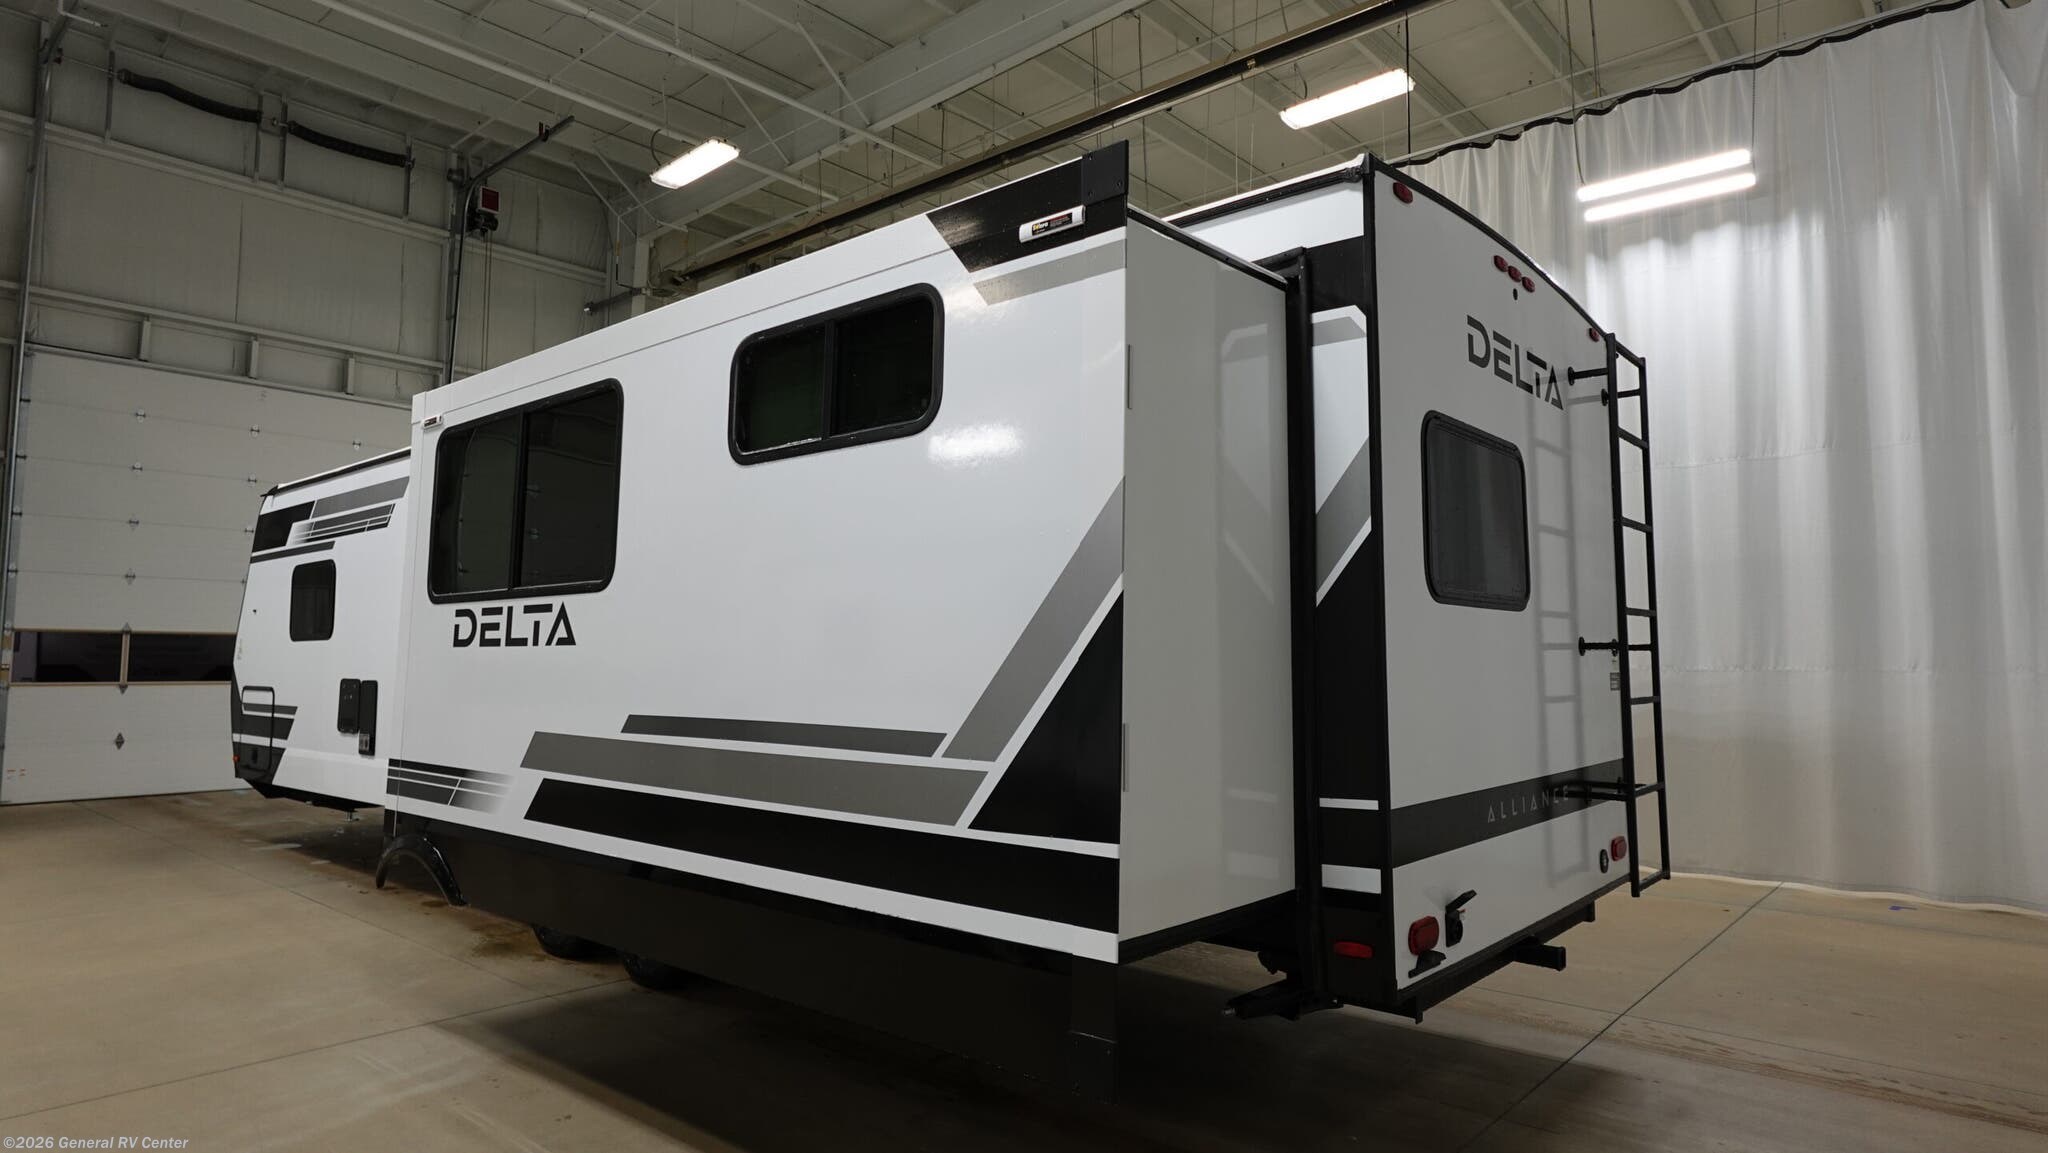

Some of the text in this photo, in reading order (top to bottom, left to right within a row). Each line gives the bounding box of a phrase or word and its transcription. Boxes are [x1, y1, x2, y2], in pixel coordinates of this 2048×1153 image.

[1467, 314, 1564, 411] DELTA
[453, 601, 576, 648] DELTA
[1487, 784, 1569, 824] ALLIANCE
